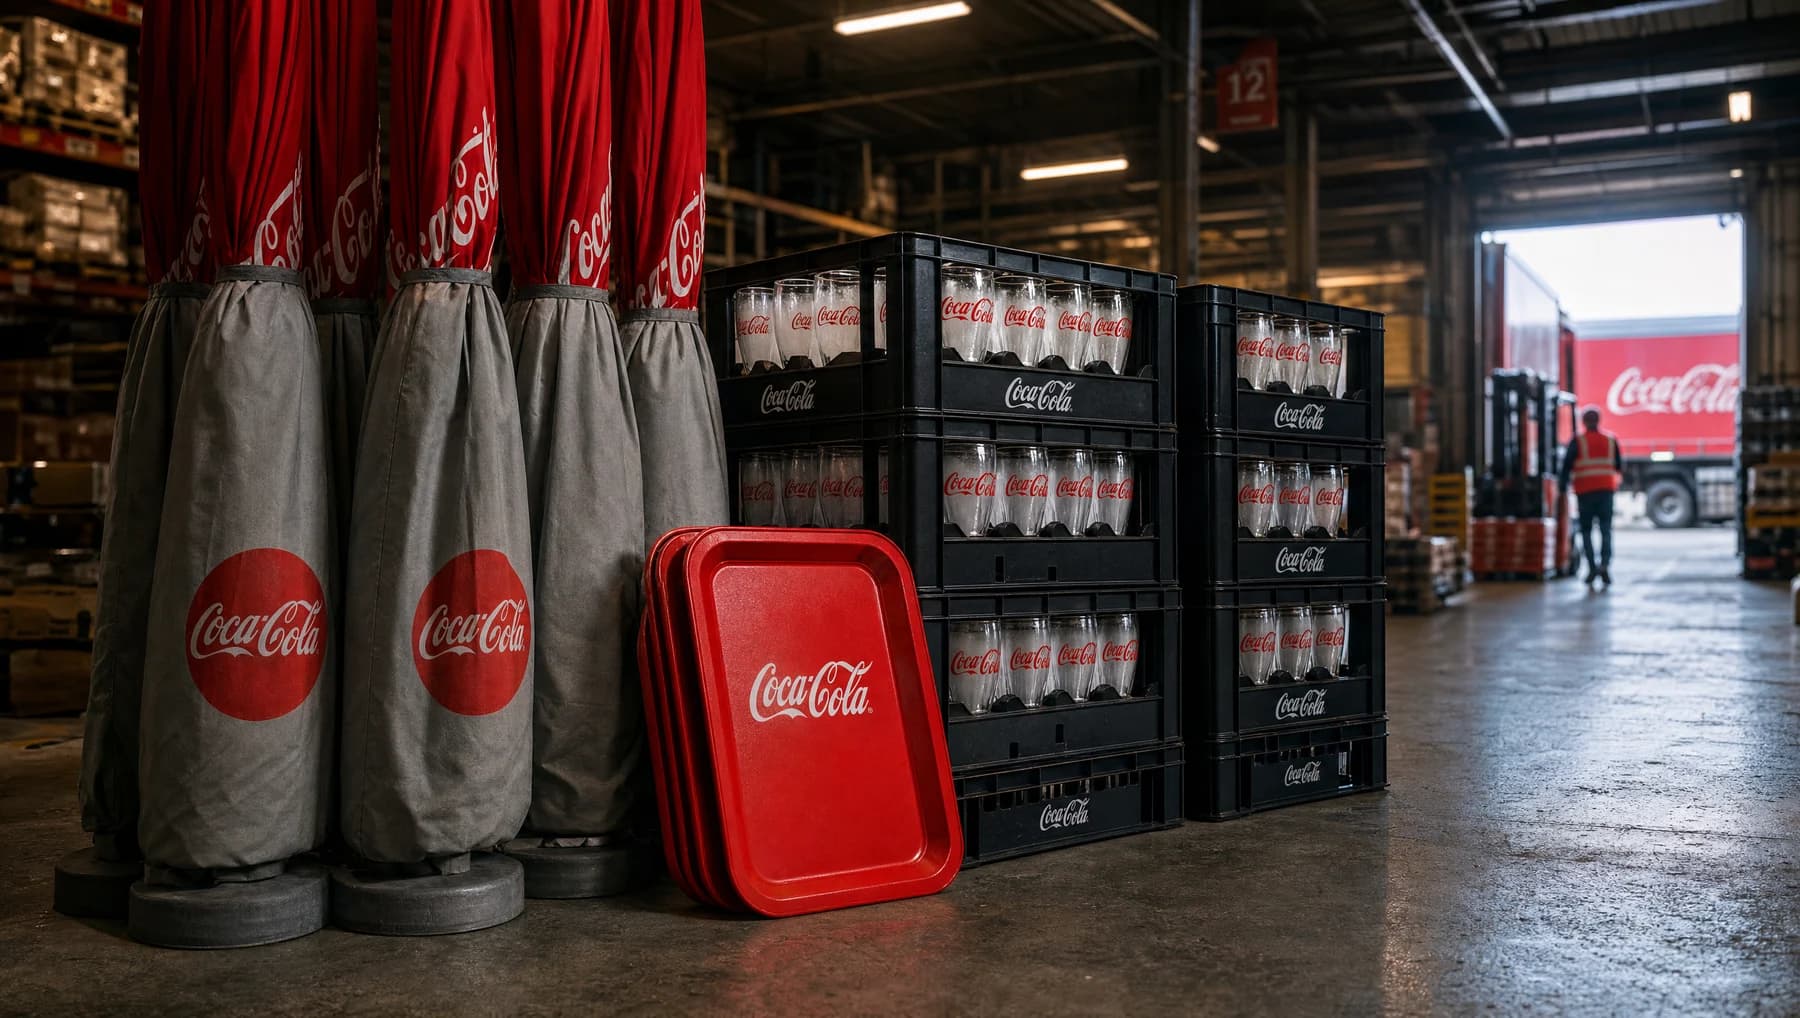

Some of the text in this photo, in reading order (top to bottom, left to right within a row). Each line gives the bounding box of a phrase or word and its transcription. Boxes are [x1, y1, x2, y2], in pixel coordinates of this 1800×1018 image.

[1226, 71, 1265, 104] 12
[761, 379, 816, 414] Coca-Cola
[1005, 377, 1075, 412] Coca-Cola
[1275, 402, 1325, 430] Coca-Cola
[1276, 547, 1326, 573] Coca-Cola
[191, 600, 321, 659] Coca-Cola
[419, 599, 525, 660] Coca-Cola
[749, 661, 872, 722] Coca-Cola
[1276, 689, 1327, 719] Coca-Cola
[1285, 761, 1321, 786] Coca-Cola
[1040, 798, 1089, 831] Coca-Cola
